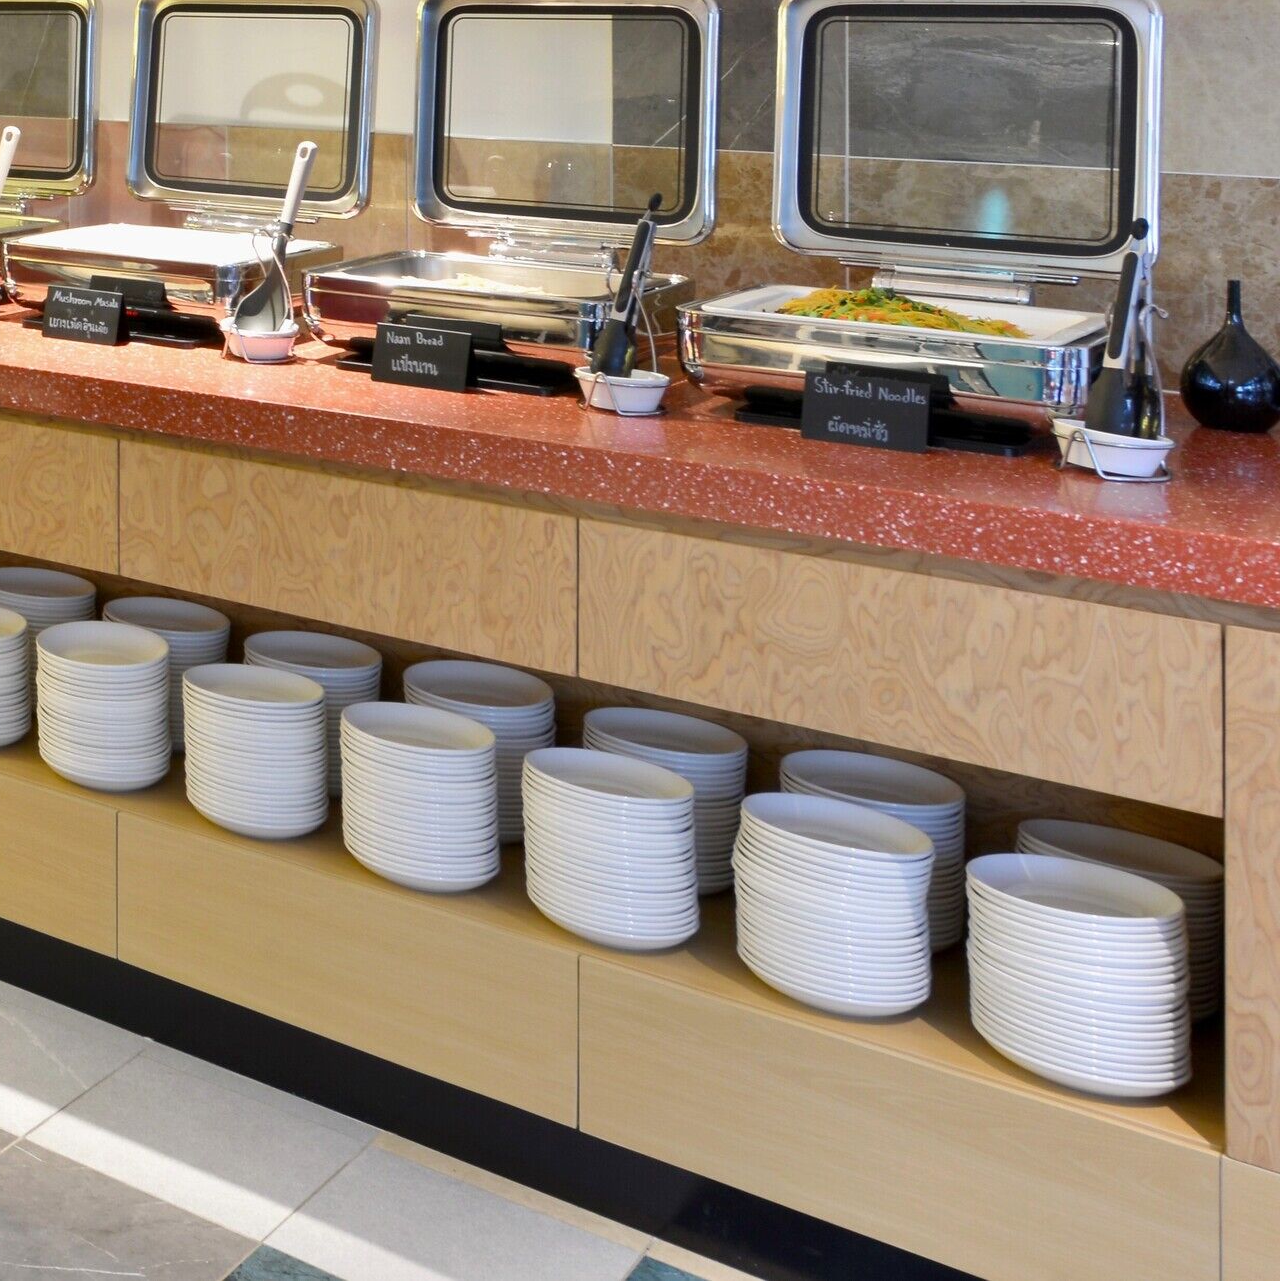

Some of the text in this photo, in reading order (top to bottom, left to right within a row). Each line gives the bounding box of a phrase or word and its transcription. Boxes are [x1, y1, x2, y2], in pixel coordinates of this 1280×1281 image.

[52, 290, 119, 309] Mushroom Masala
[386, 331, 444, 346] Naan Bread
[814, 376, 927, 405] Stir-fried Noodles
